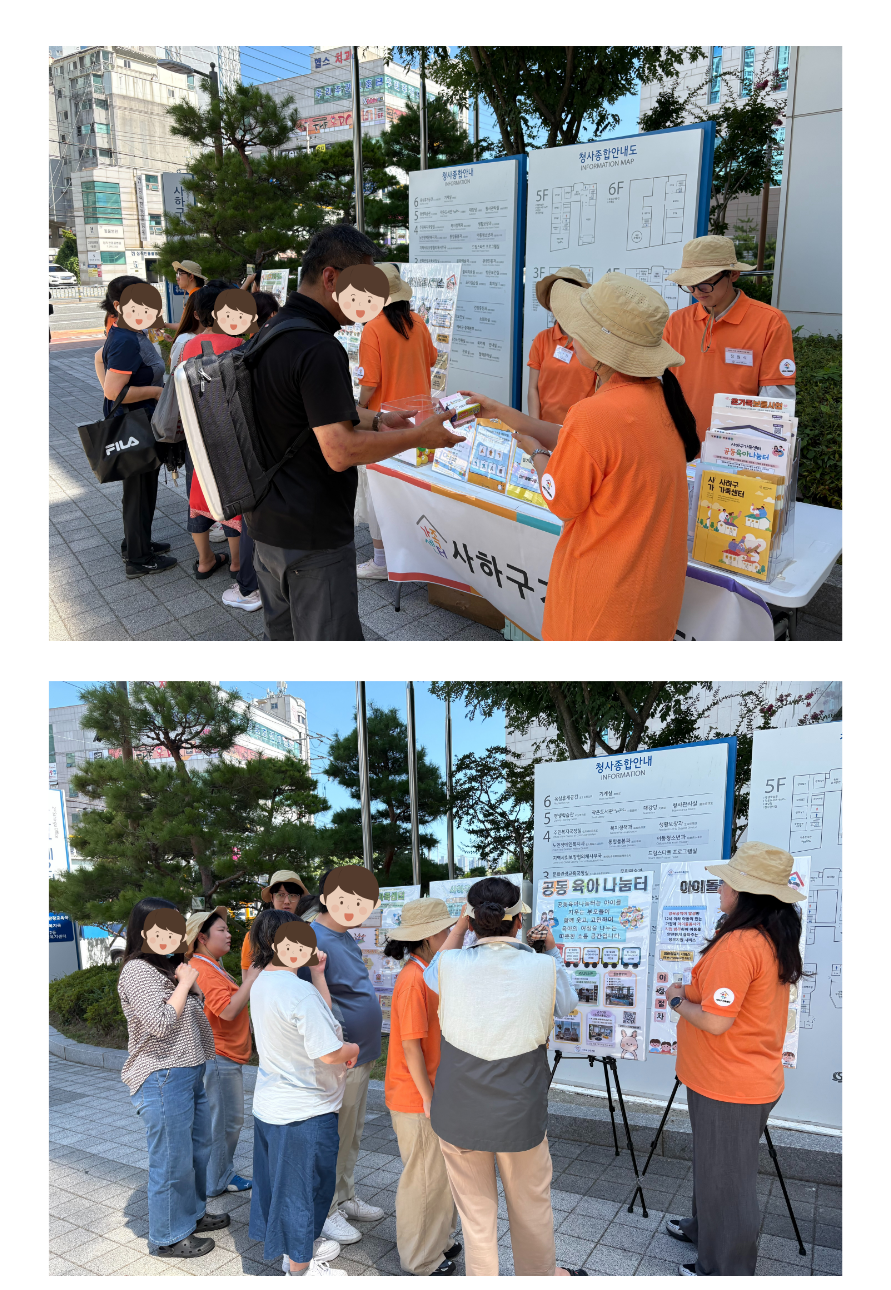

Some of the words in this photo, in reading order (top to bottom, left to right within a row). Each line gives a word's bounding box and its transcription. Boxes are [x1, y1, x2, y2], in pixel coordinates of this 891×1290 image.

[315, 57, 330, 69] 헬스
[579, 144, 638, 164] 청사종합안내도
[581, 160, 620, 171] INFORMATION
[620, 158, 635, 167] MAP
[442, 168, 474, 181] 청사종합안내
[608, 181, 625, 196] 6F
[536, 189, 549, 202] 5F
[414, 197, 419, 208] 6
[414, 211, 418, 221] 5
[414, 225, 418, 235] 4
[533, 267, 546, 279] 3F
[105, 436, 140, 456] FILA
[719, 479, 739, 489] 사하구
[719, 485, 745, 498] 가족센터
[596, 755, 653, 774] 청사종합안내
[600, 770, 646, 781] INFORMATION
[765, 777, 787, 794] 5F
[543, 795, 552, 808] 6
[543, 812, 551, 825] 5
[543, 830, 551, 843] 4
[542, 879, 569, 897] 공동
[572, 877, 599, 894] 육아
[603, 876, 648, 892] 나눔터
[680, 879, 722, 894] 아이돌
